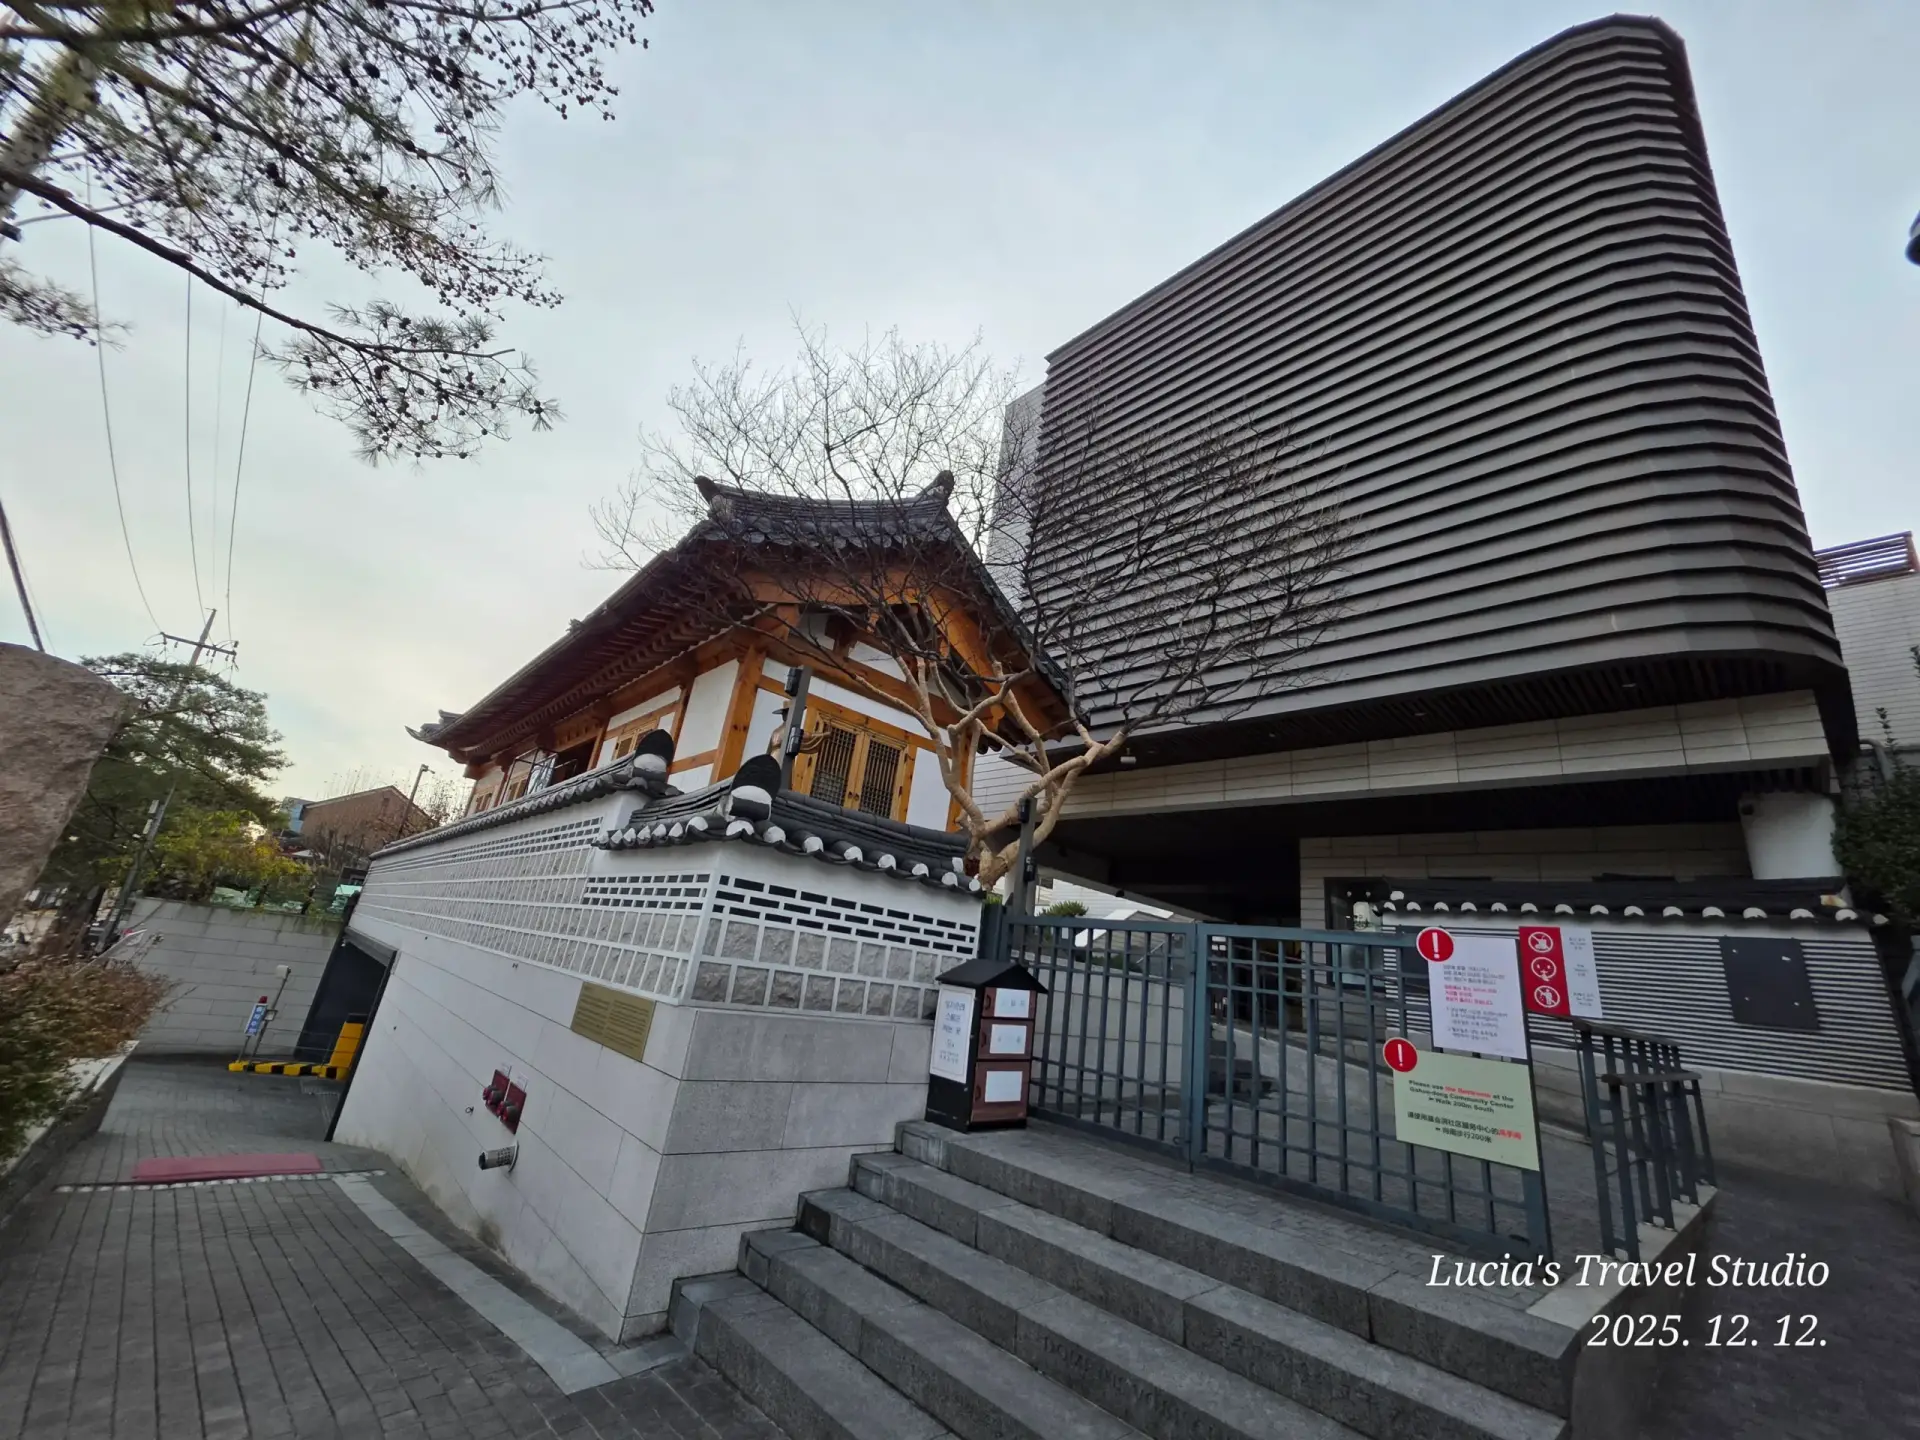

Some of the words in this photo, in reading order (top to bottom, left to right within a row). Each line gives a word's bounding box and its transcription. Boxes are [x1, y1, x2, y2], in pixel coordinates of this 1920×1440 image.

[1408, 1079, 1430, 1088] Please
[1501, 1094, 1514, 1102] the
[1435, 1097, 1452, 1106] Walk
[1453, 1100, 1473, 1109] 200m
[1473, 1104, 1495, 1114] South
[1449, 1093, 1489, 1106] Community
[1489, 1100, 1514, 1109] Center
